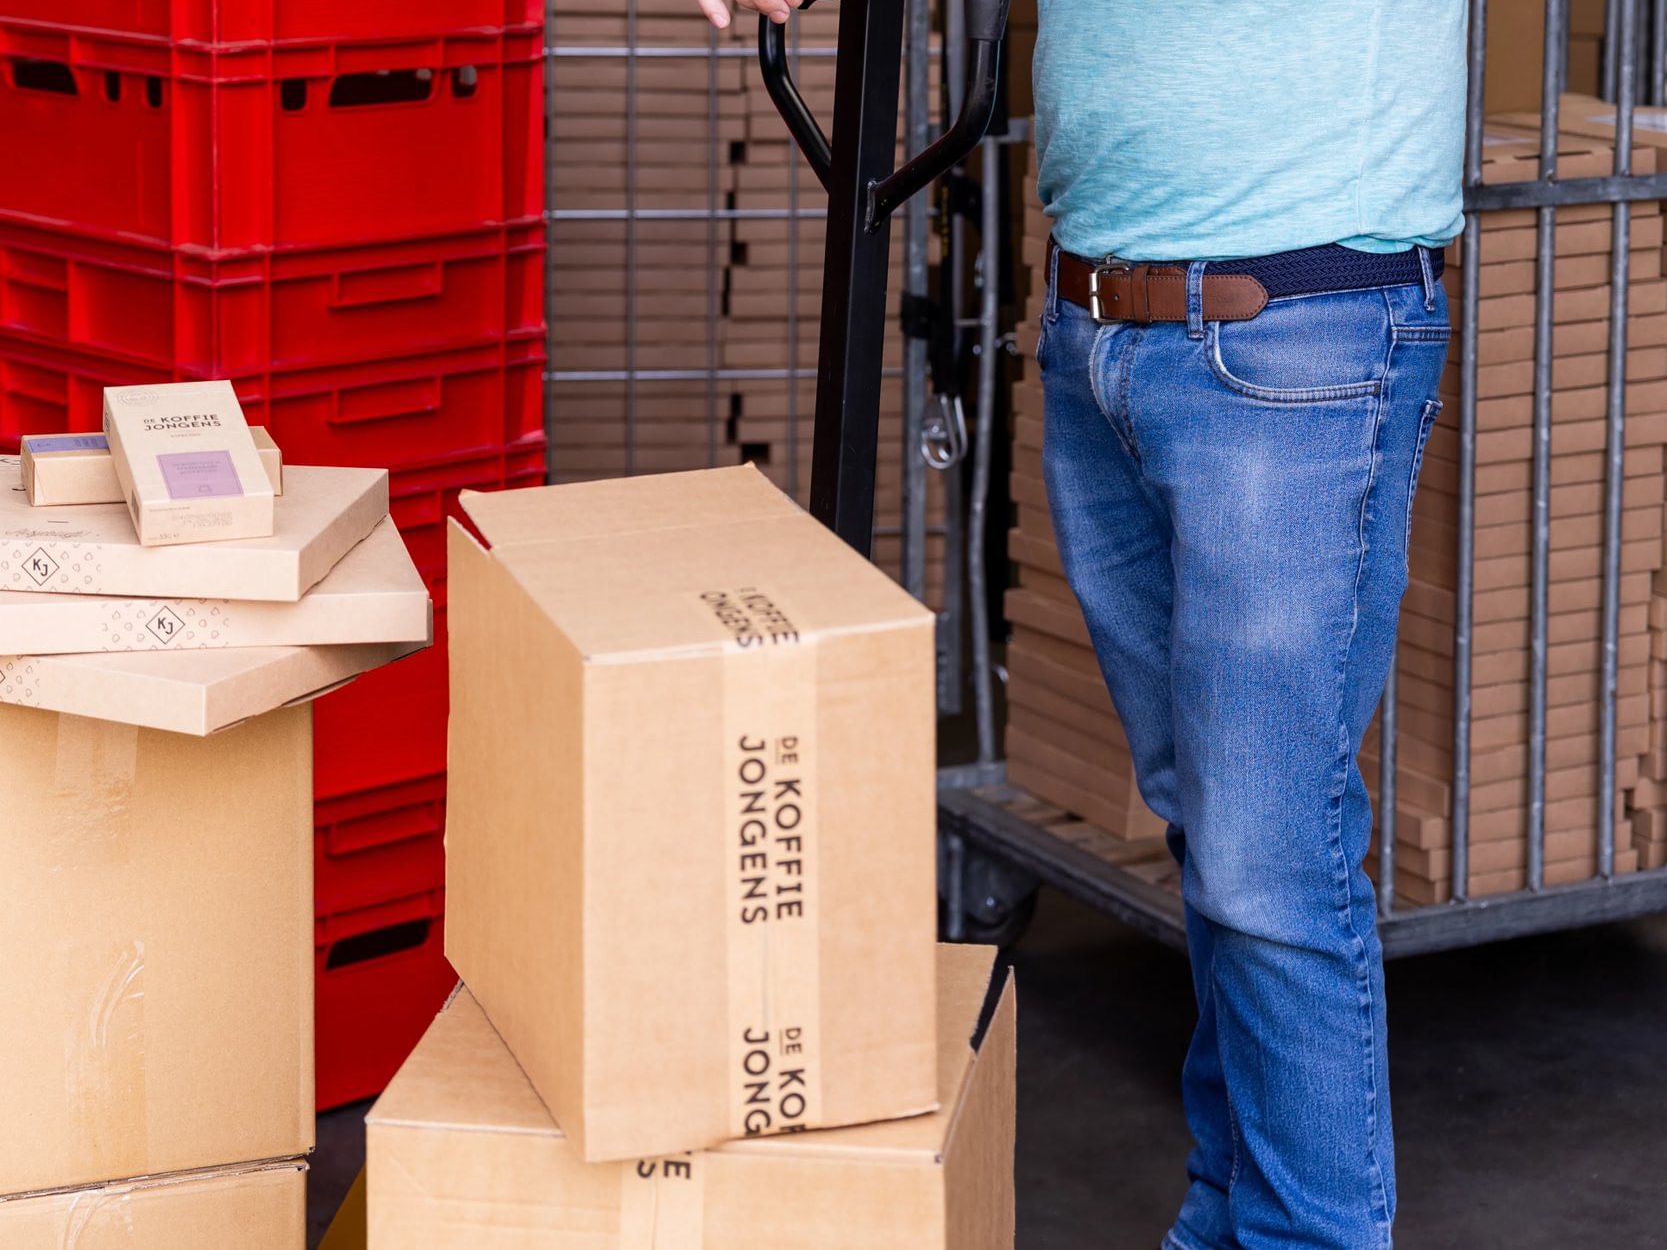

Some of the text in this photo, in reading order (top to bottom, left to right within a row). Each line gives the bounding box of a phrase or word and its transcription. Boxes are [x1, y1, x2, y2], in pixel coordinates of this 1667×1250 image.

[144, 420, 222, 432] JONGENS
[161, 414, 220, 424] KOFFIE
[738, 735, 768, 924] JONGENS
[774, 736, 803, 920] DE KOFFIE
[784, 1027, 802, 1055] DE
